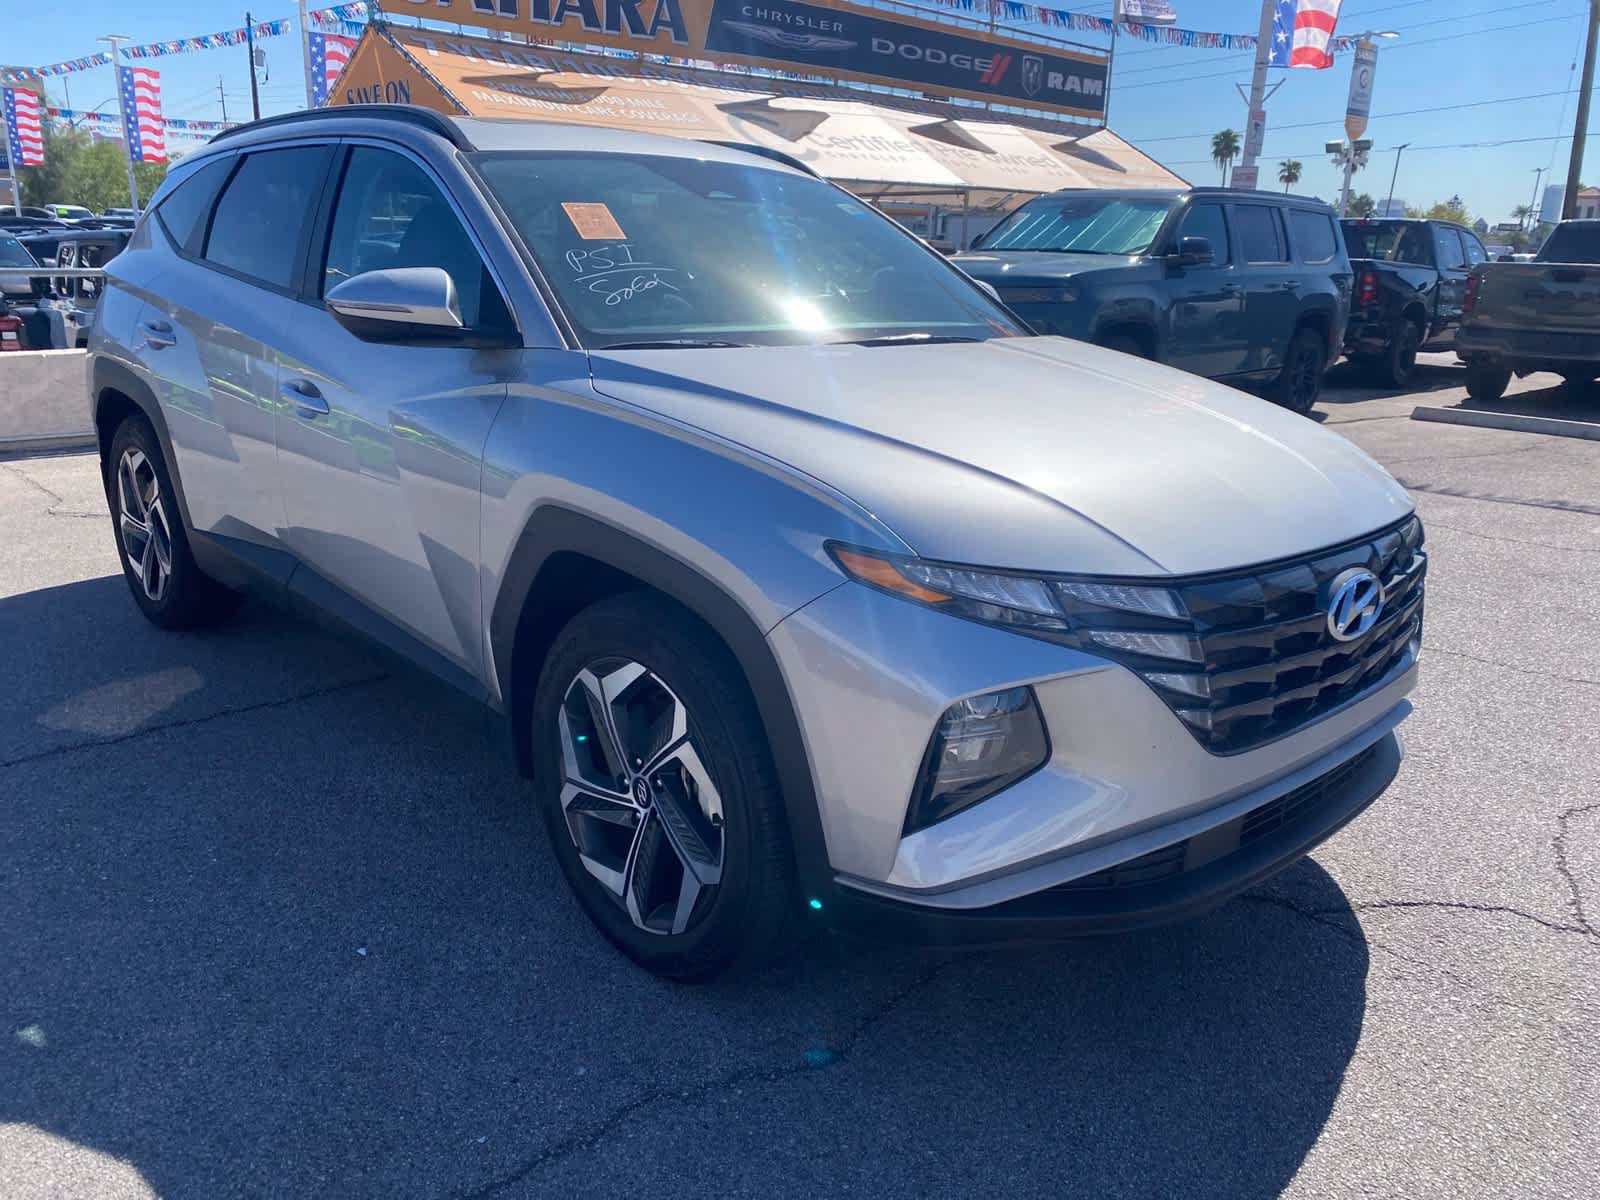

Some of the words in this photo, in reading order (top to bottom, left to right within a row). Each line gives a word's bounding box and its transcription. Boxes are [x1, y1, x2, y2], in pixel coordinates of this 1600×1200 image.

[742, 6, 843, 32] CHRYSLER
[871, 37, 993, 73] DODGE
[385, 79, 414, 104] ON
[1047, 71, 1104, 96] RAM
[806, 132, 930, 153] Certified
[566, 243, 654, 272] PSI
